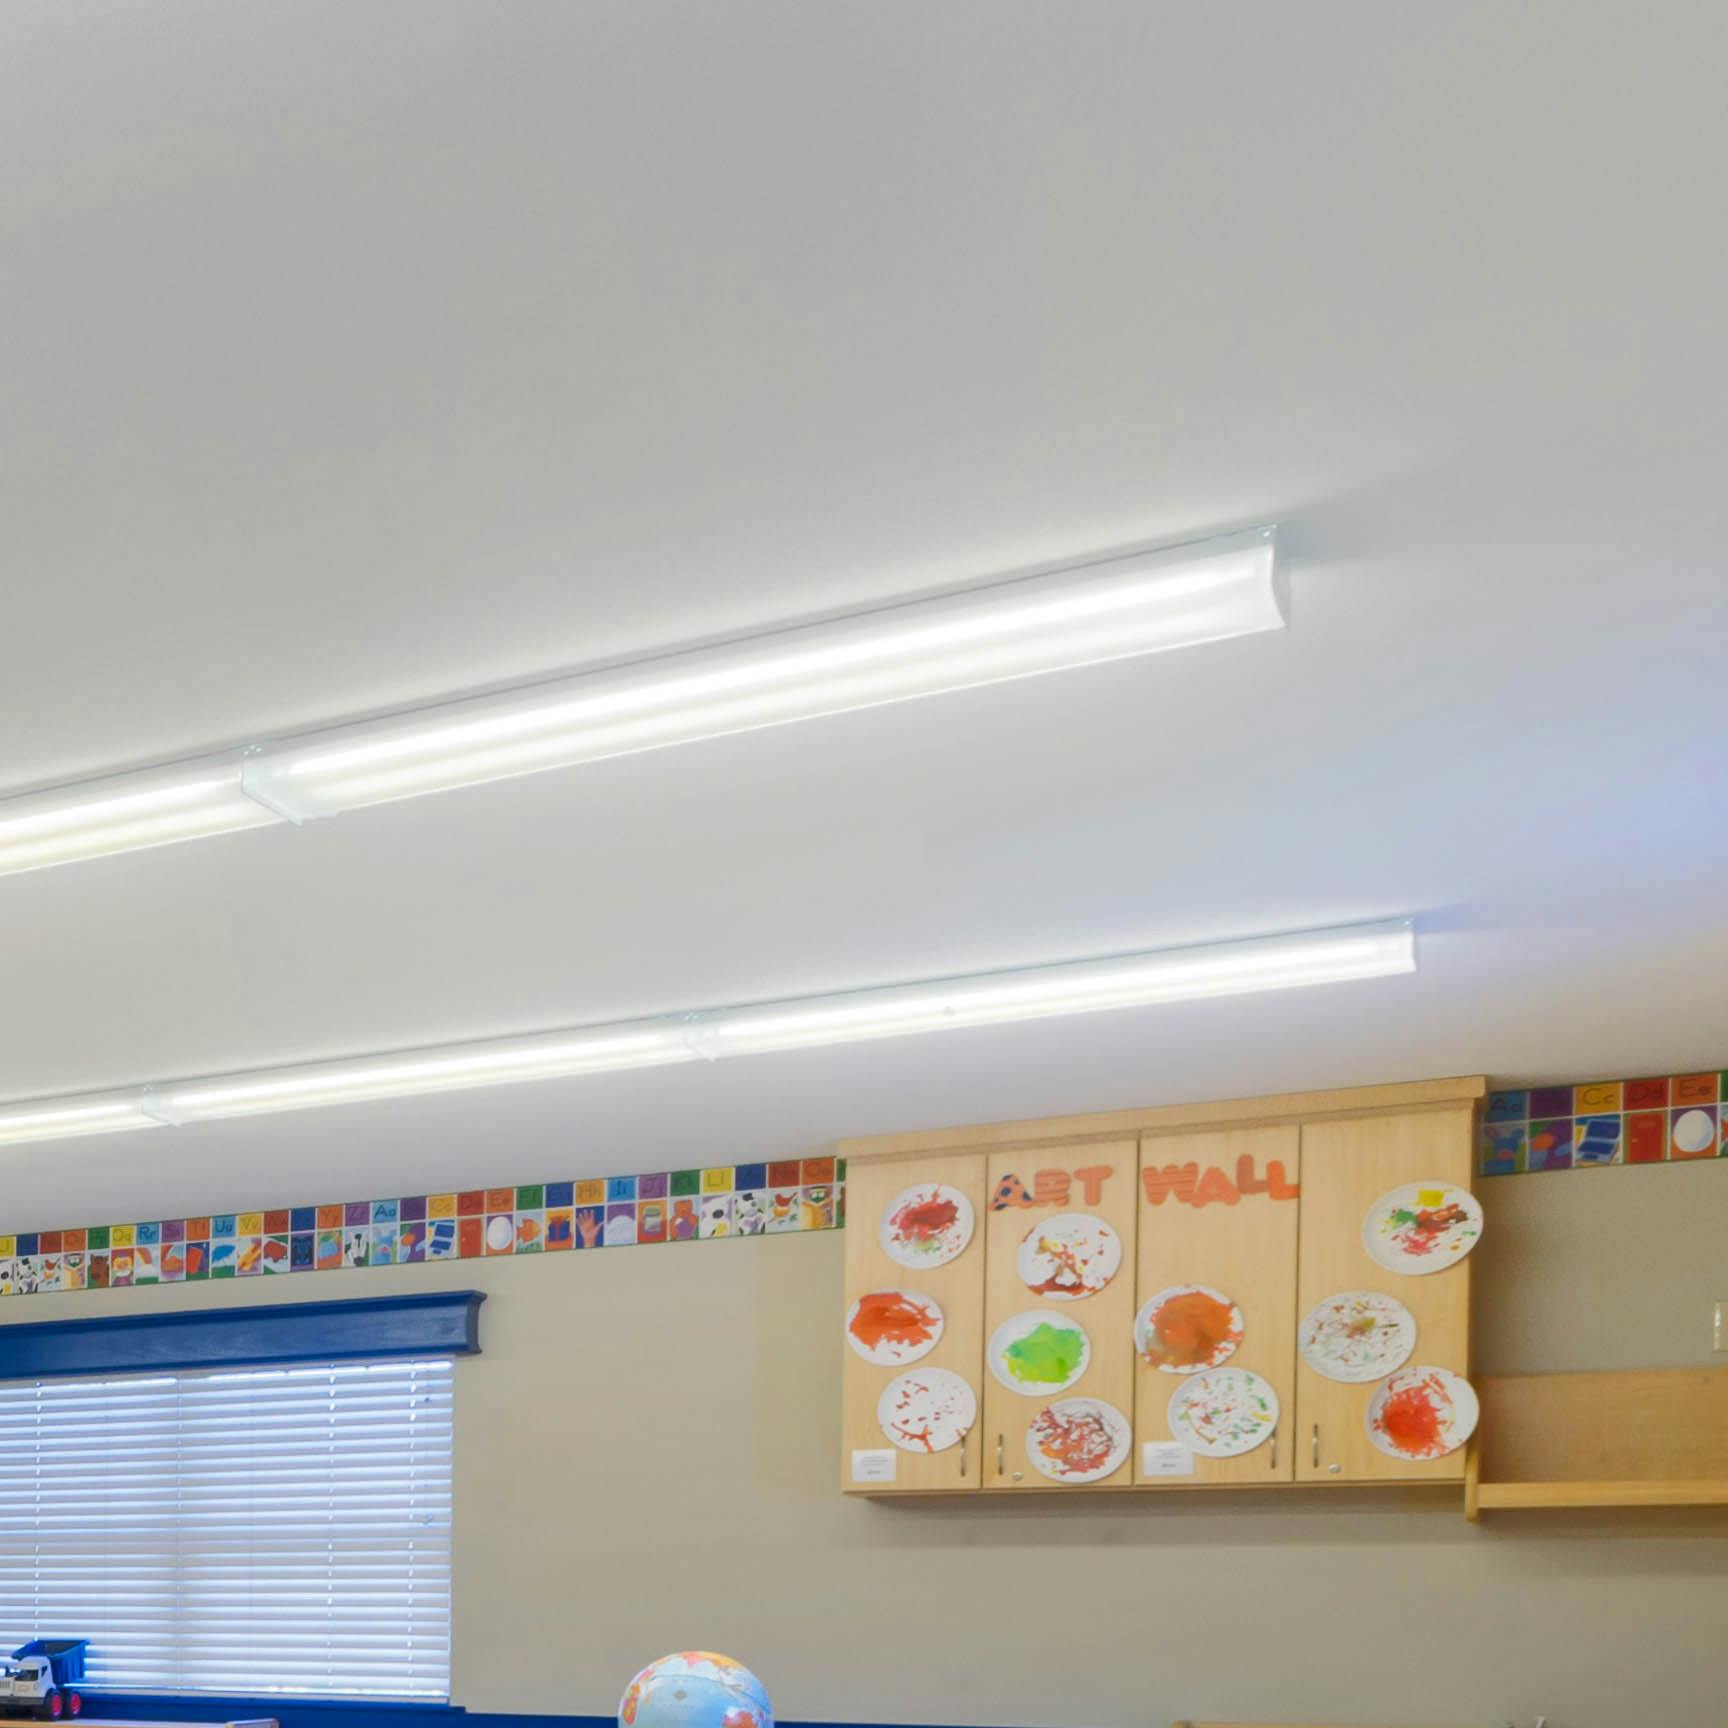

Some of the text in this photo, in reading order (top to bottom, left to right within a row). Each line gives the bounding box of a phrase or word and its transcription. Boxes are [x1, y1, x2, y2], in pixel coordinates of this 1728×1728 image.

[1581, 1087, 1617, 1106] Cc
[1679, 1078, 1713, 1098] Ee
[988, 1153, 1301, 1212] ART WALL
